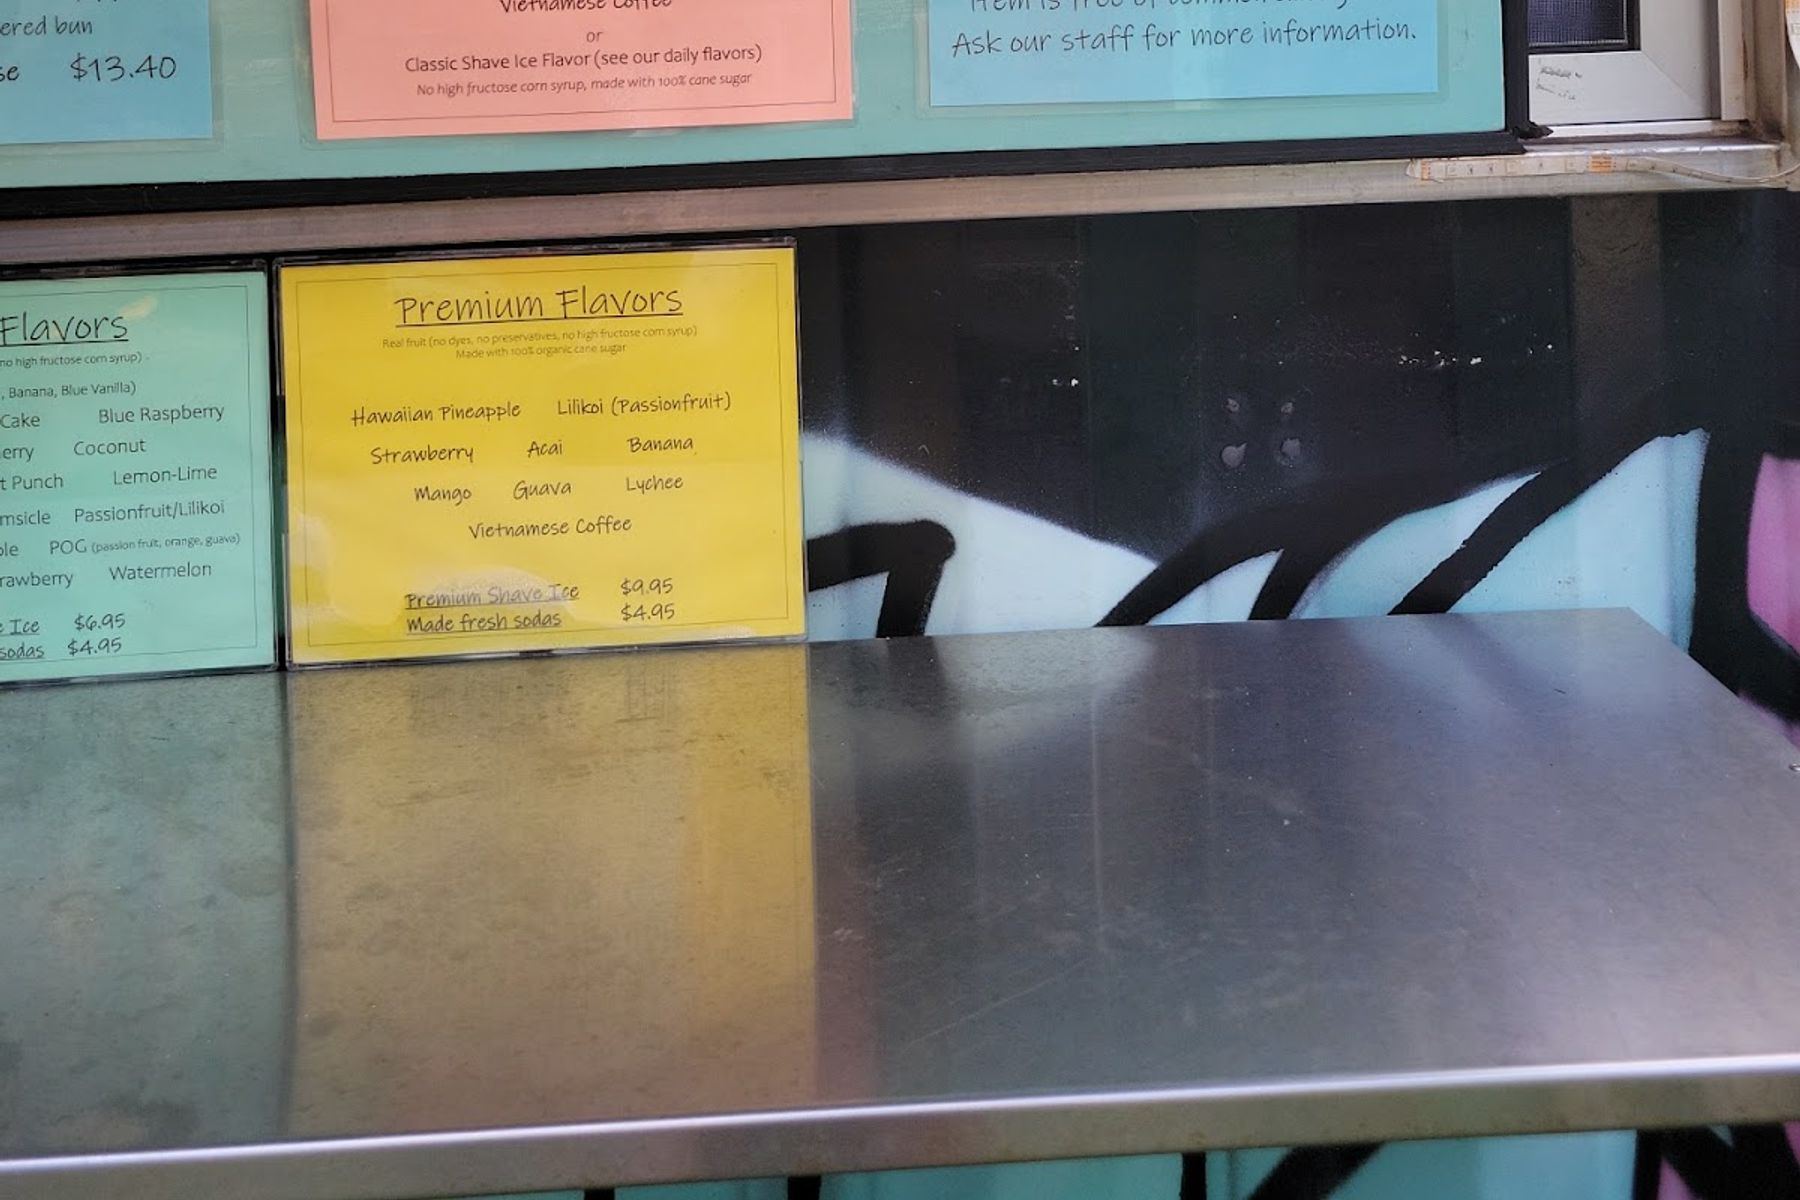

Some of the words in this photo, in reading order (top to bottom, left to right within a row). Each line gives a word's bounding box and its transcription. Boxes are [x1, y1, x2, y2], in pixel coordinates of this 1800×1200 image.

[55, 16, 93, 35] bun
[586, 31, 603, 43] or
[70, 53, 176, 81] $13.40
[405, 57, 458, 72] Classic
[462, 55, 510, 70] Shave
[515, 55, 538, 68] Ice
[542, 53, 591, 67] Flavor
[594, 50, 628, 69] (see
[633, 52, 660, 64] our
[663, 47, 699, 65] daily
[702, 44, 762, 63] flavors)
[394, 291, 547, 326] Premium
[552, 285, 683, 320] Flavors
[0, 312, 129, 341] Flavors
[9, 387, 57, 398] Banana,
[61, 385, 88, 396] Blue
[90, 381, 136, 396] Vanilla)
[0, 413, 40, 428] Cake
[99, 408, 135, 424] Blue
[140, 405, 224, 424] Raspberry
[351, 407, 433, 427] Hawaiian
[438, 401, 521, 422] Pineapple
[558, 399, 603, 415] Lilikoi
[611, 391, 731, 416] (Passionfruit)
[74, 439, 146, 456] Coconut
[371, 445, 473, 465] Strawberry
[527, 441, 562, 458] Acai
[627, 437, 693, 453] Banana
[12, 473, 64, 490] Punch
[114, 466, 217, 485] Lemon-Lime
[414, 486, 472, 506] Mango
[513, 480, 571, 500] Guava
[626, 475, 683, 494] Lychee
[75, 501, 224, 523] Passionfruit/Lilikoi
[468, 522, 569, 539] Vietnamese
[576, 515, 632, 534] Coffee
[50, 539, 87, 555] POG
[109, 561, 211, 580] Watermelon
[404, 593, 485, 610] Premium
[484, 585, 547, 606] Shave
[545, 583, 579, 602] Ice
[620, 578, 673, 596] $9.95
[6, 619, 40, 636] Ice
[74, 613, 125, 631] $6.95
[407, 614, 457, 635] Made
[456, 613, 511, 633] fresh
[510, 609, 562, 630] sodas
[621, 603, 675, 622] $4.95
[67, 637, 122, 656] $4.95
